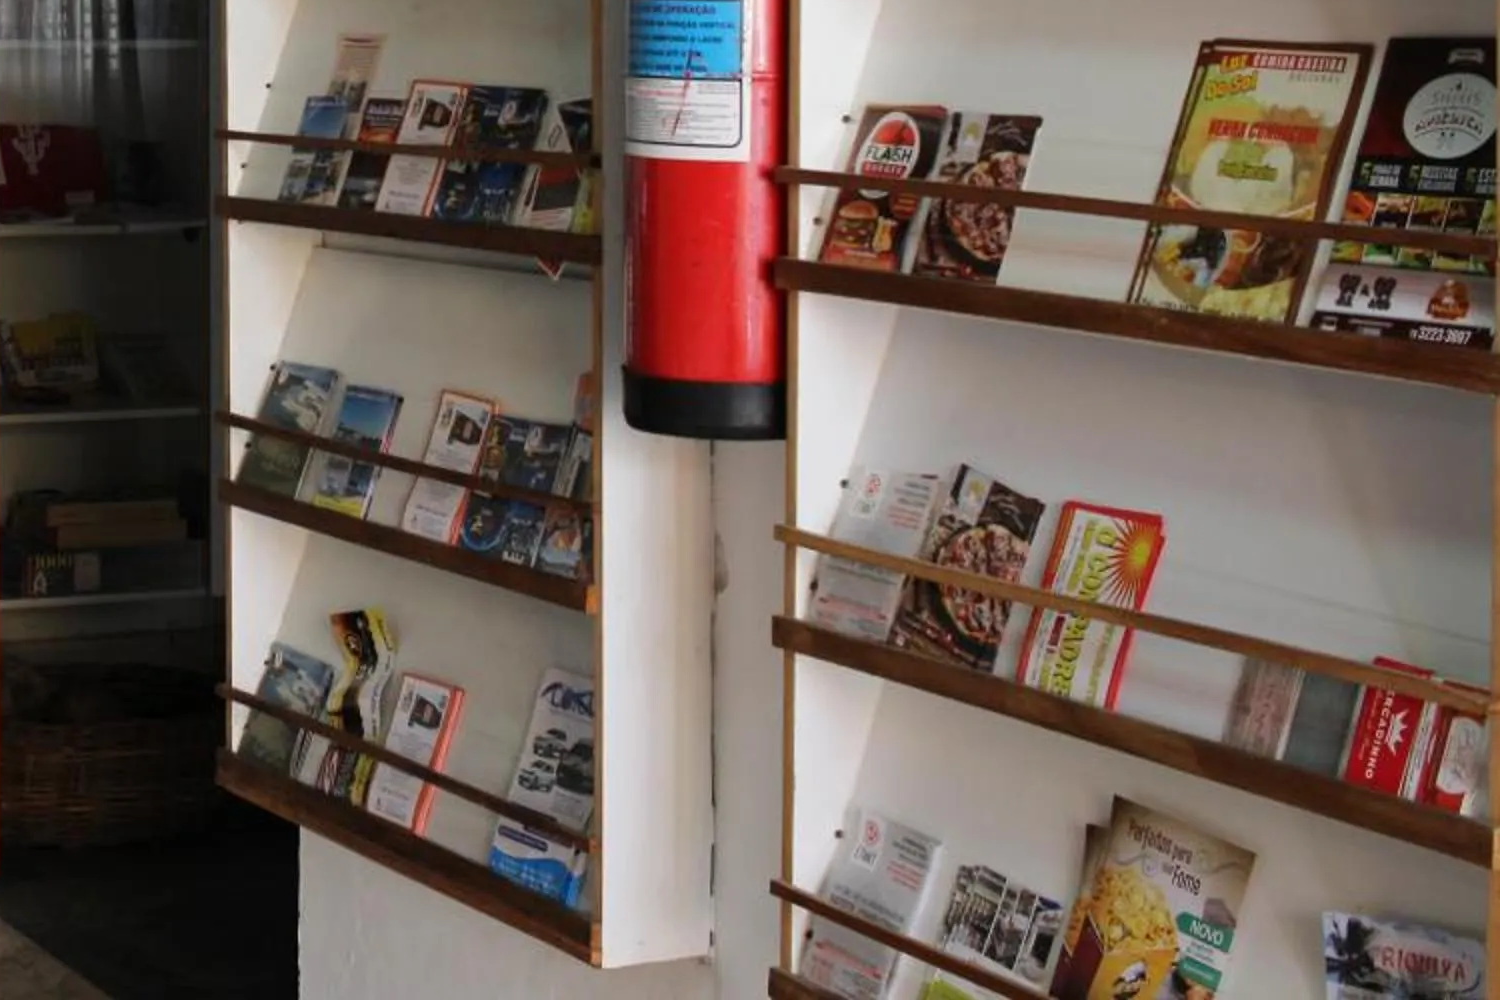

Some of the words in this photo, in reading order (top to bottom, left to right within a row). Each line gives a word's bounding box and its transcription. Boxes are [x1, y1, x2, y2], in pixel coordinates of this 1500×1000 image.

[1252, 53, 1296, 69] COMIDA
[1297, 55, 1346, 73] CASEIRA
[865, 145, 913, 163] FLASH
[1188, 919, 1225, 946] NOVO
